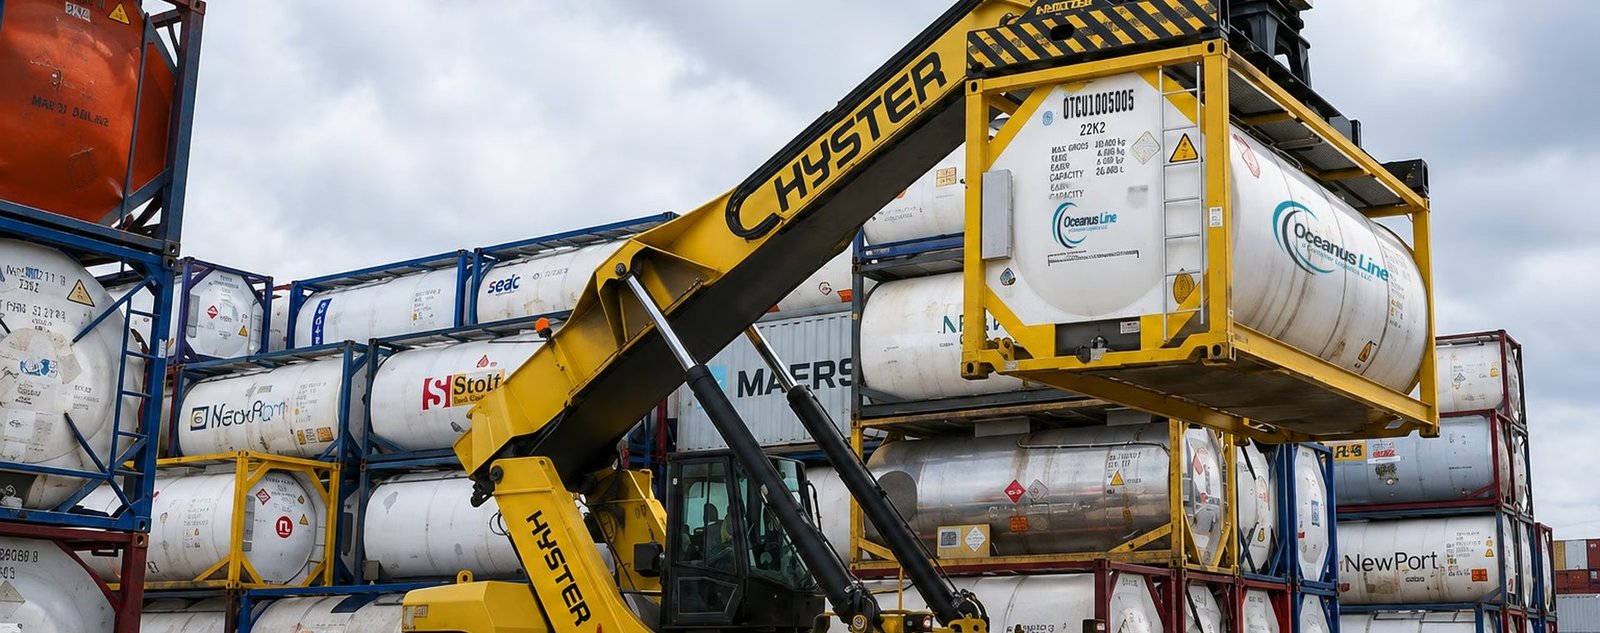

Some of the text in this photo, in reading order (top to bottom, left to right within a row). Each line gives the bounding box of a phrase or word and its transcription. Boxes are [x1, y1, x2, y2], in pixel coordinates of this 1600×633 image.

[1080, 121, 1106, 136] 22K2
[1063, 211, 1117, 228] Oceanus Line
[1294, 222, 1389, 282] Oceanus Line
[525, 510, 592, 627] HYSTER
